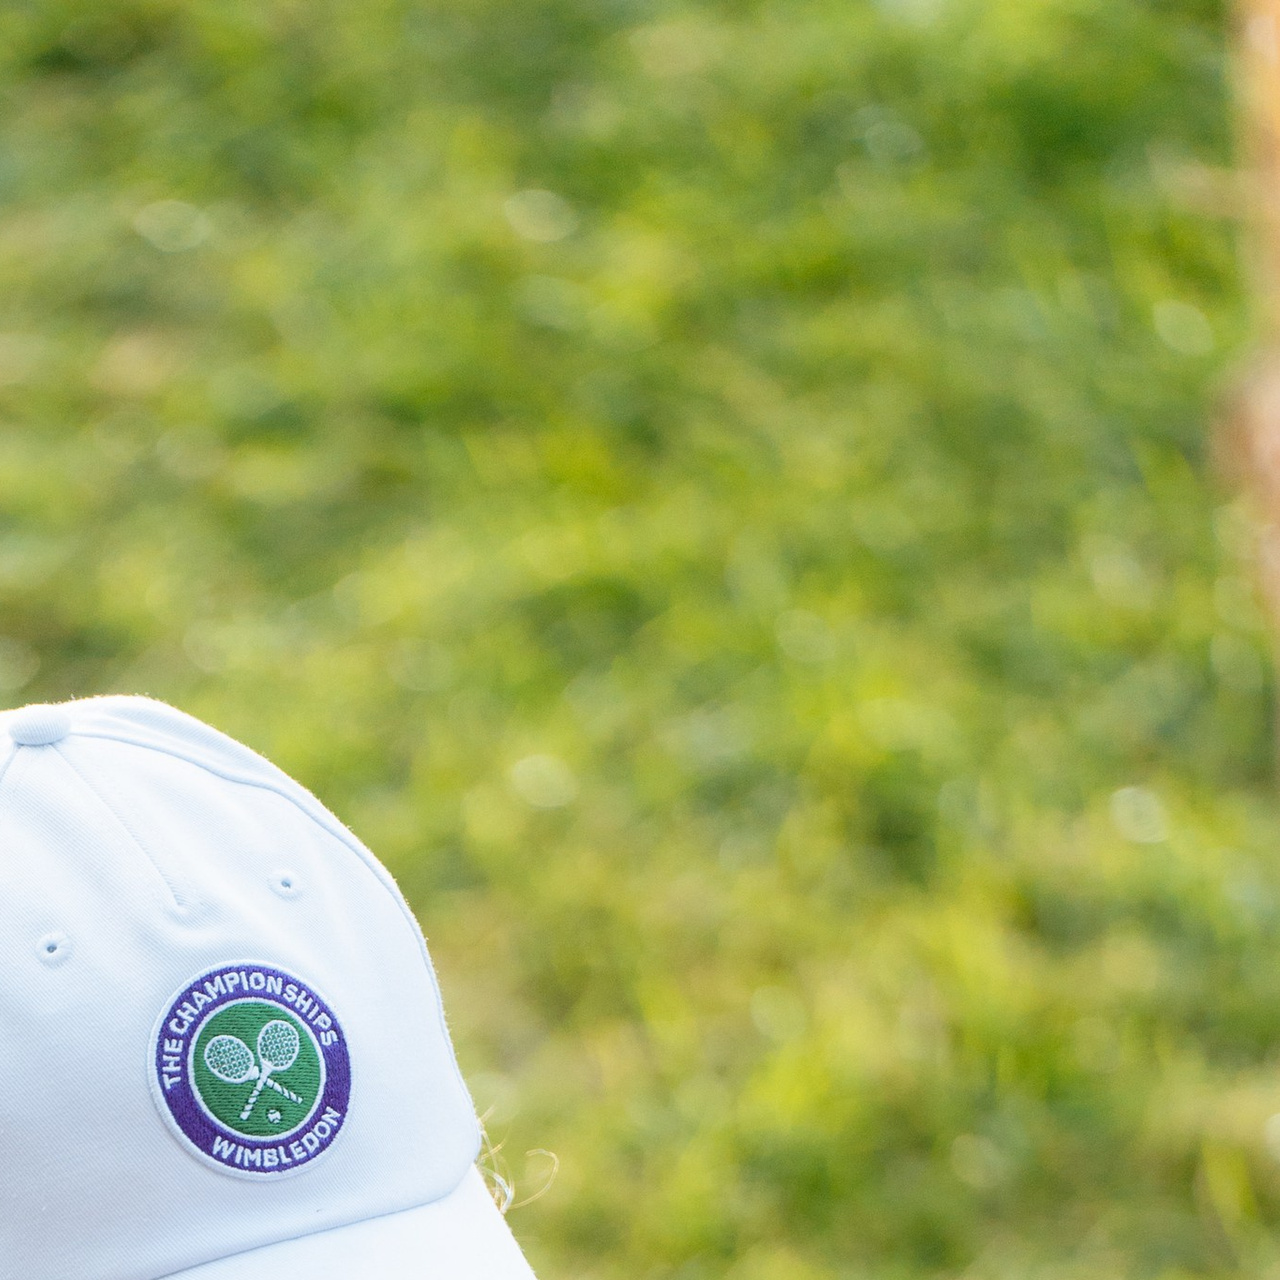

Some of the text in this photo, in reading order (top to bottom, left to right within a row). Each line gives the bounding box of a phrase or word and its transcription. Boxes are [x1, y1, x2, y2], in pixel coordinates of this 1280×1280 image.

[162, 971, 338, 1090] THE CHAMPIONSHIPS
[212, 1106, 340, 1168] WIMBLEDON
